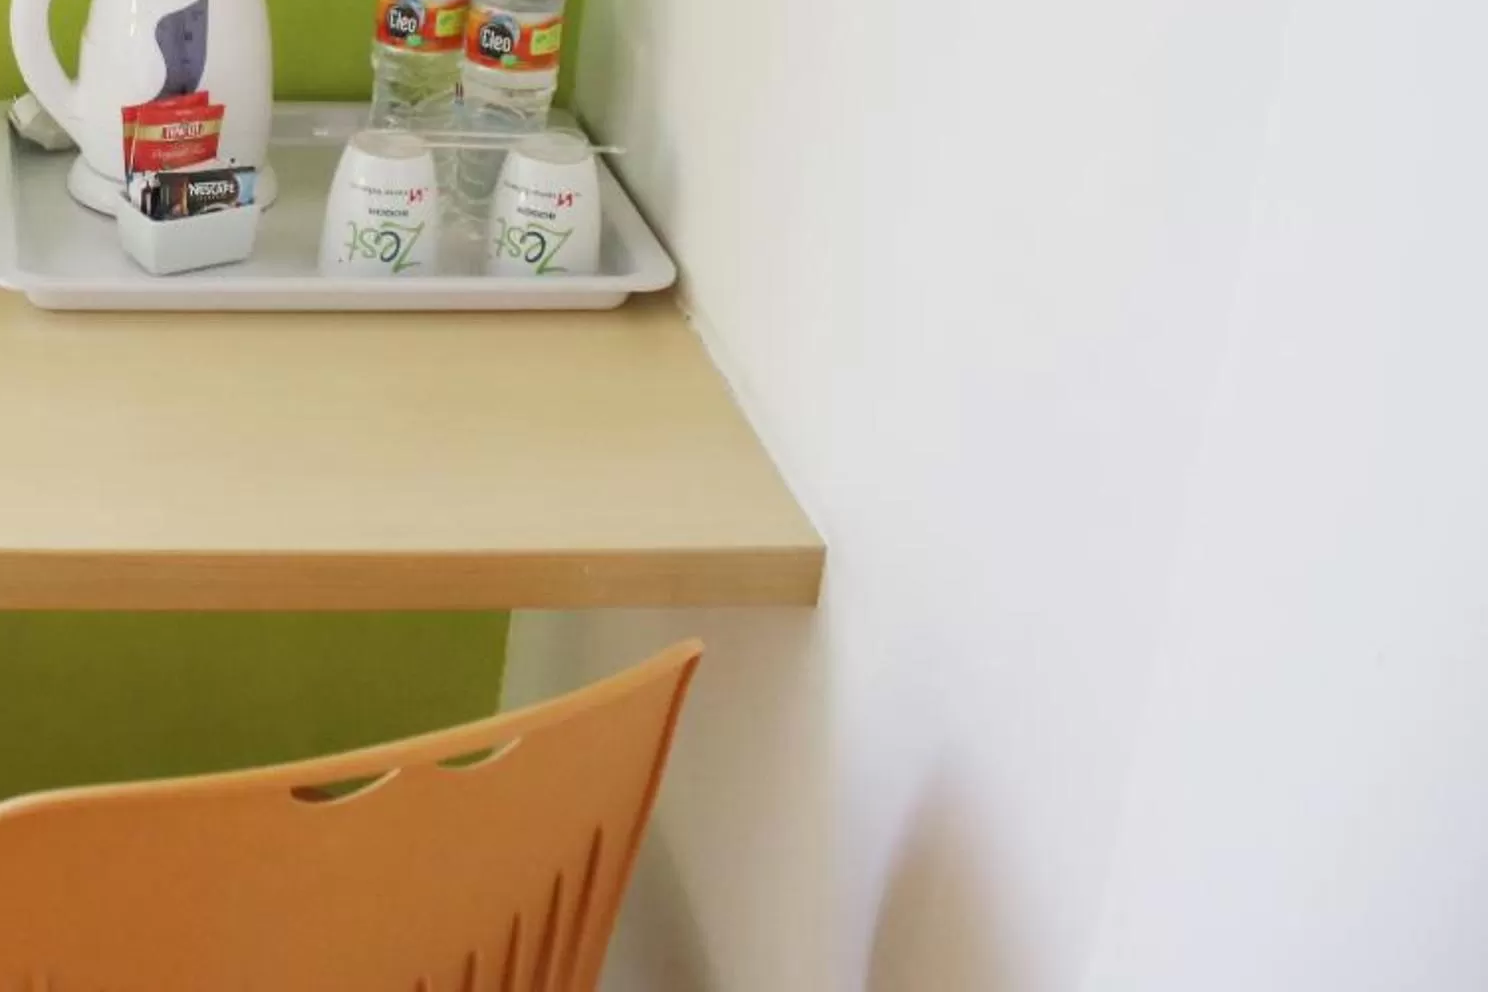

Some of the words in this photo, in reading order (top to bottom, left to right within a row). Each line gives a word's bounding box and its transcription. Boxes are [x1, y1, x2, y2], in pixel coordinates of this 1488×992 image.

[388, 10, 417, 34] Cleo
[480, 28, 511, 53] Cleo
[343, 220, 425, 274] Zest
[493, 217, 574, 275] Zest
